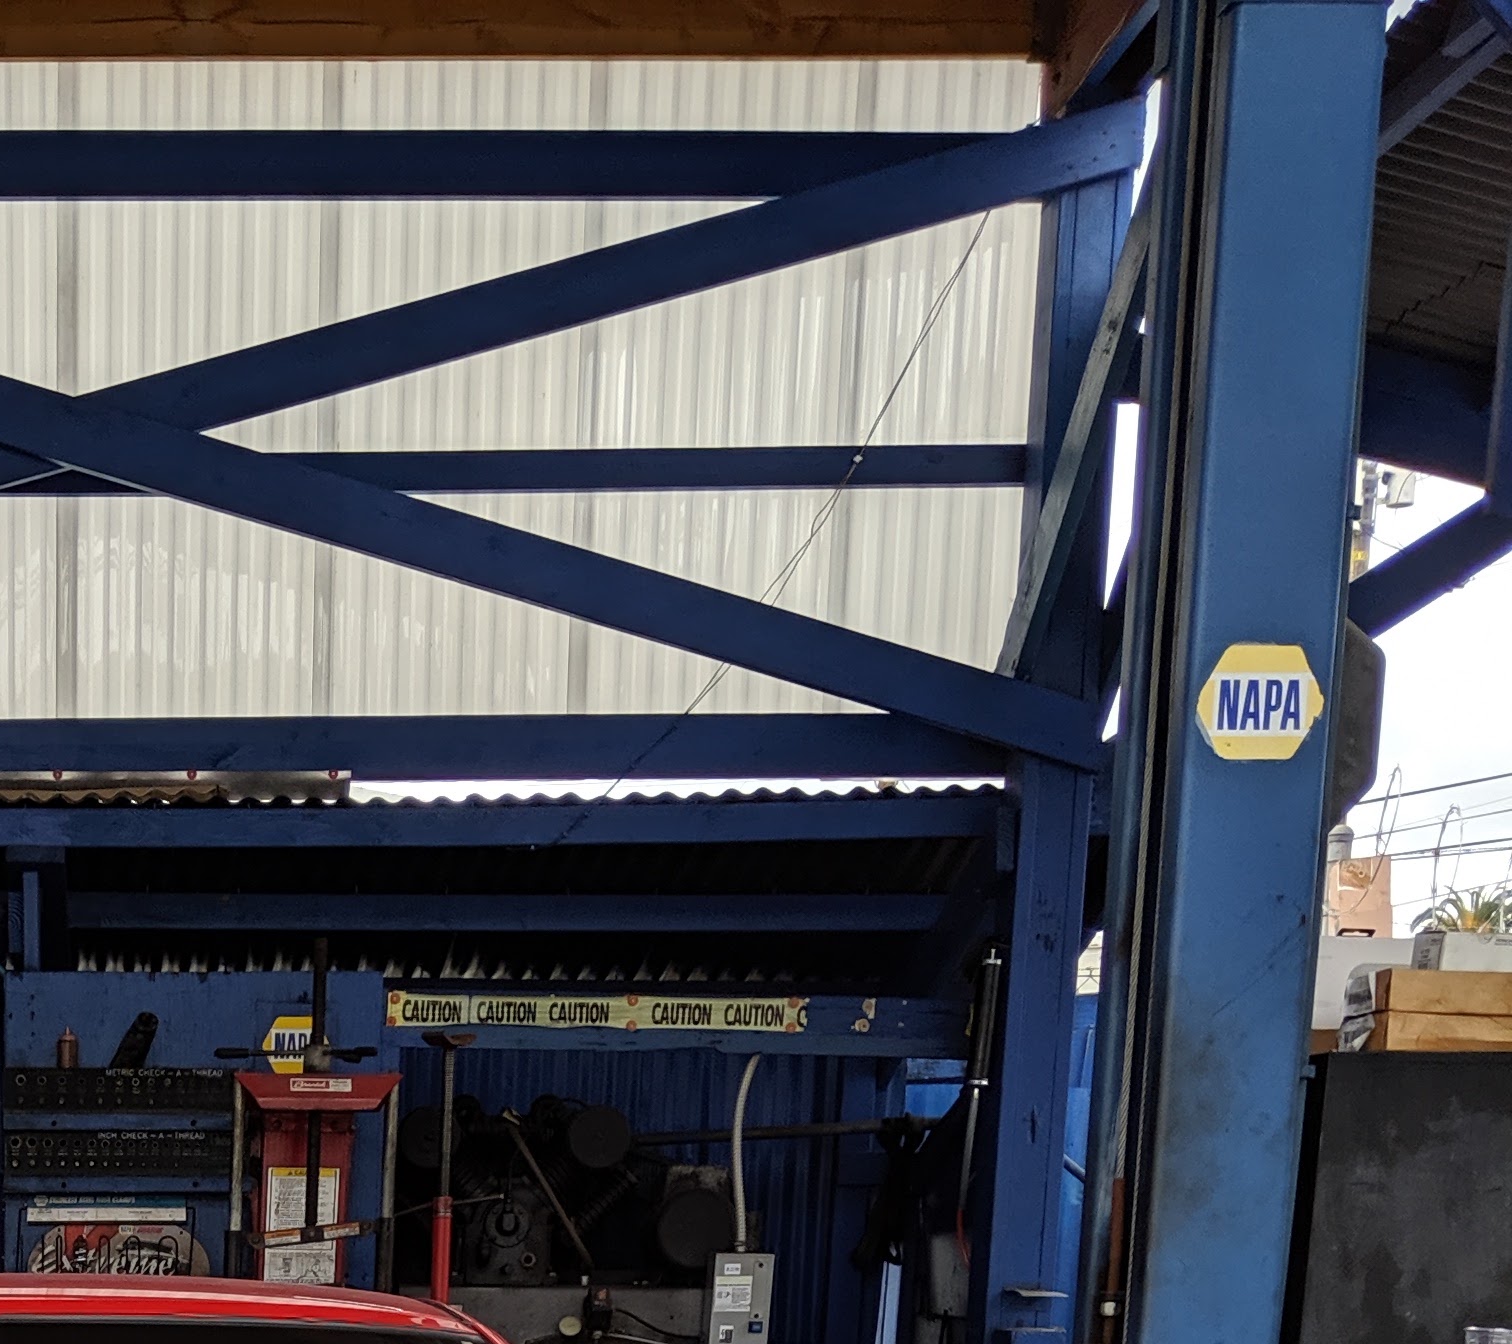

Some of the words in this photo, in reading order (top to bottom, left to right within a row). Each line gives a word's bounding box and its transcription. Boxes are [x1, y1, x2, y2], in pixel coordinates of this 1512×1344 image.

[1216, 679, 1300, 731] NAPA
[402, 999, 462, 1023] CAUTION
[476, 1001, 536, 1024] CAUTION
[548, 1002, 609, 1024] CAUTION
[651, 1002, 712, 1026] CAUTION
[724, 1003, 785, 1027] CAUTION
[274, 1032, 308, 1060] NAP
[105, 1068, 134, 1077] METRIC
[138, 1068, 165, 1077] CHECK
[192, 1069, 223, 1077] THREAD
[97, 1132, 118, 1140] INCH
[121, 1132, 148, 1140] CHECK
[174, 1132, 206, 1140] THREAD
